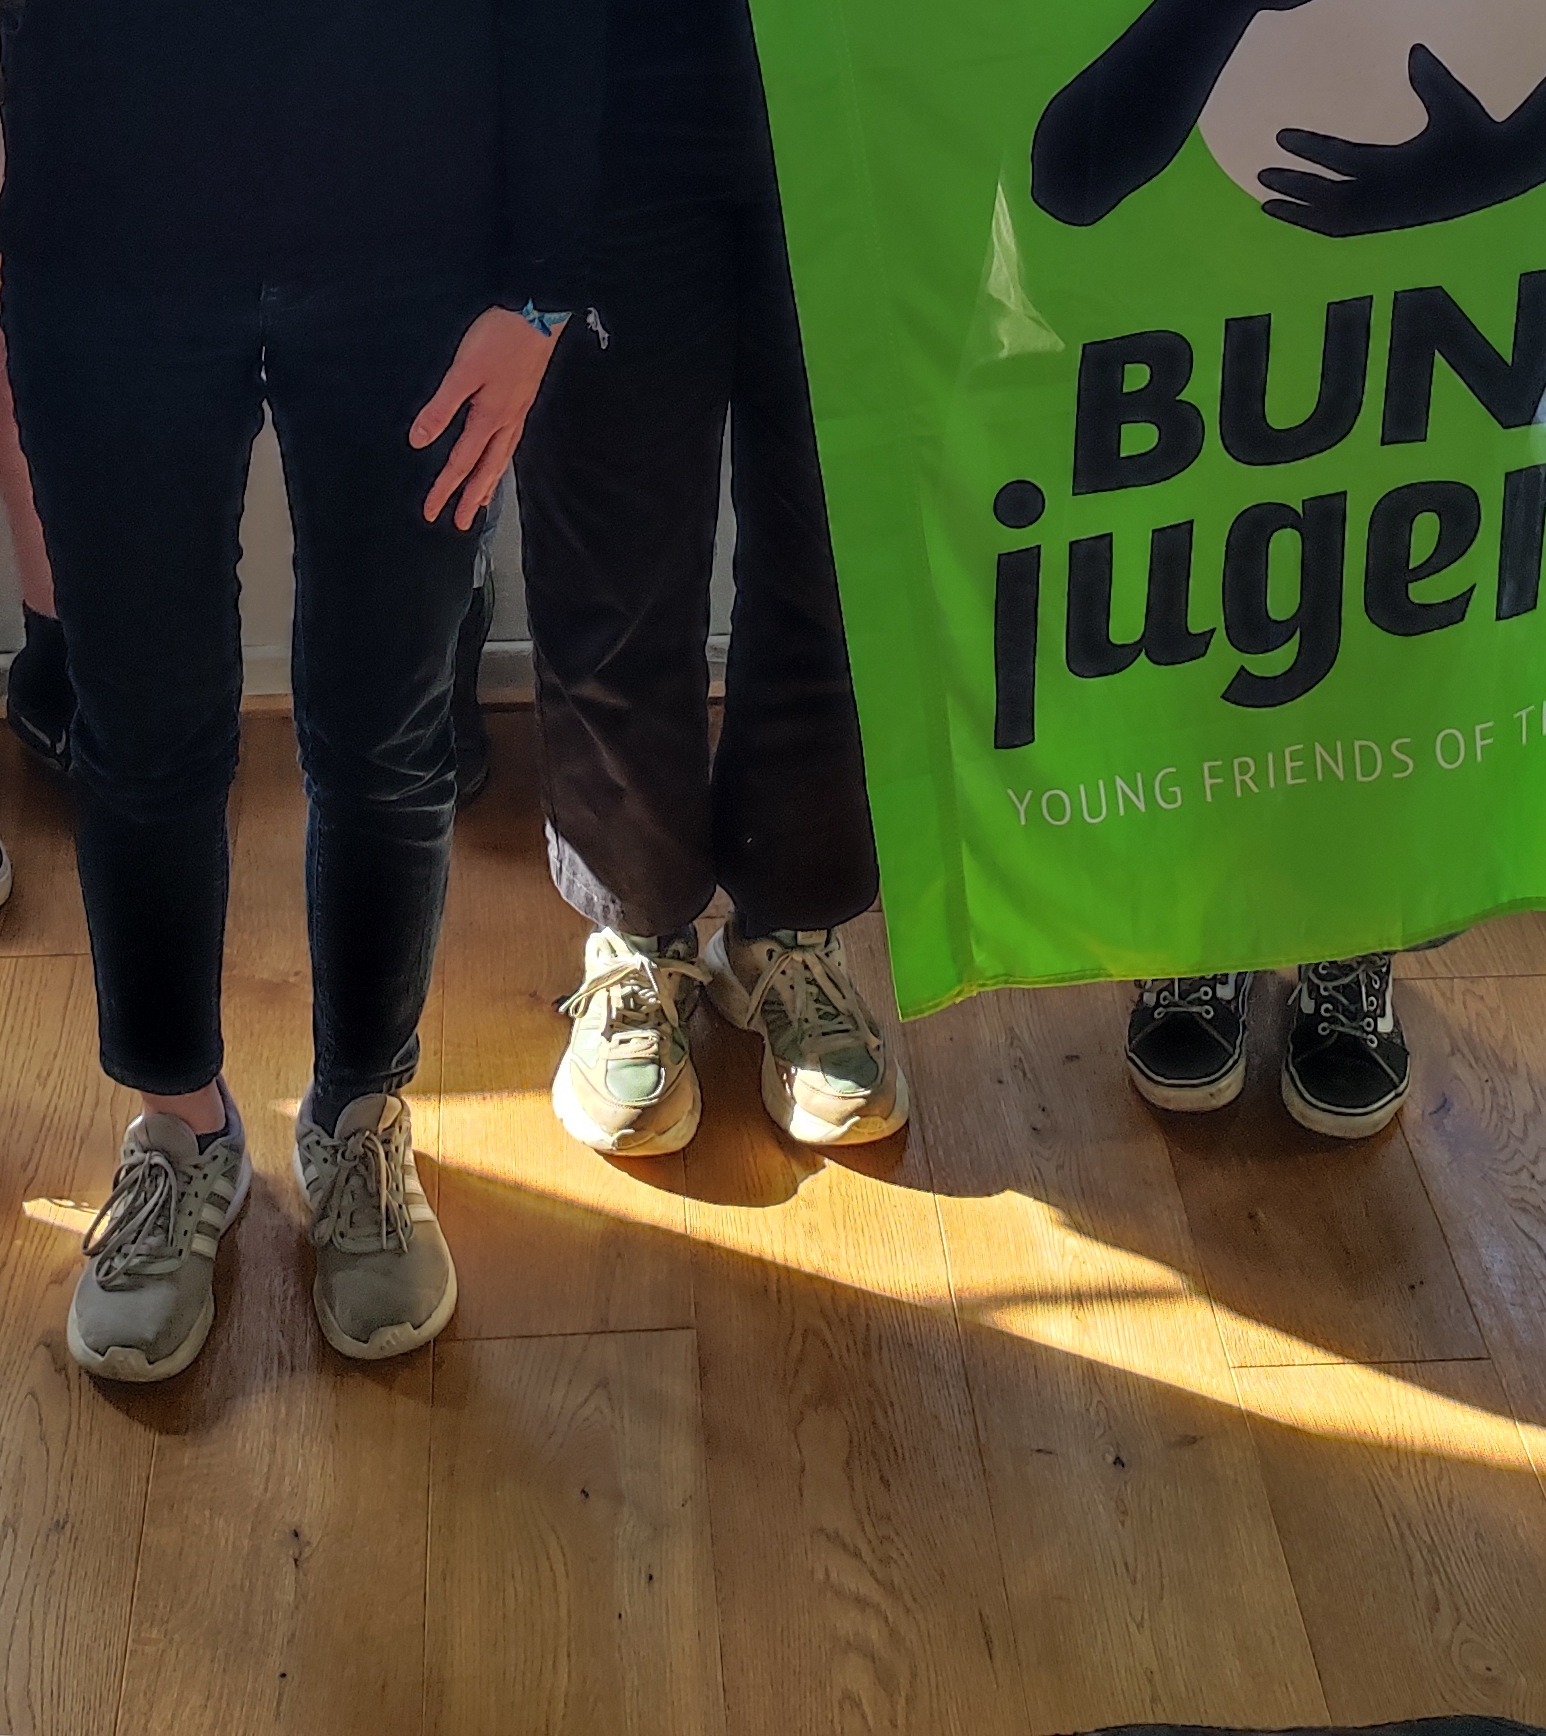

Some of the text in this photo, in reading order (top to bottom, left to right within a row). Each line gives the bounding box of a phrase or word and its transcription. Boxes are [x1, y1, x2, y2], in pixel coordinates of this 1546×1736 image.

[1007, 767, 1183, 826] YOUNG
[1203, 737, 1415, 803] FRIENDS
[1434, 721, 1495, 770] OF
